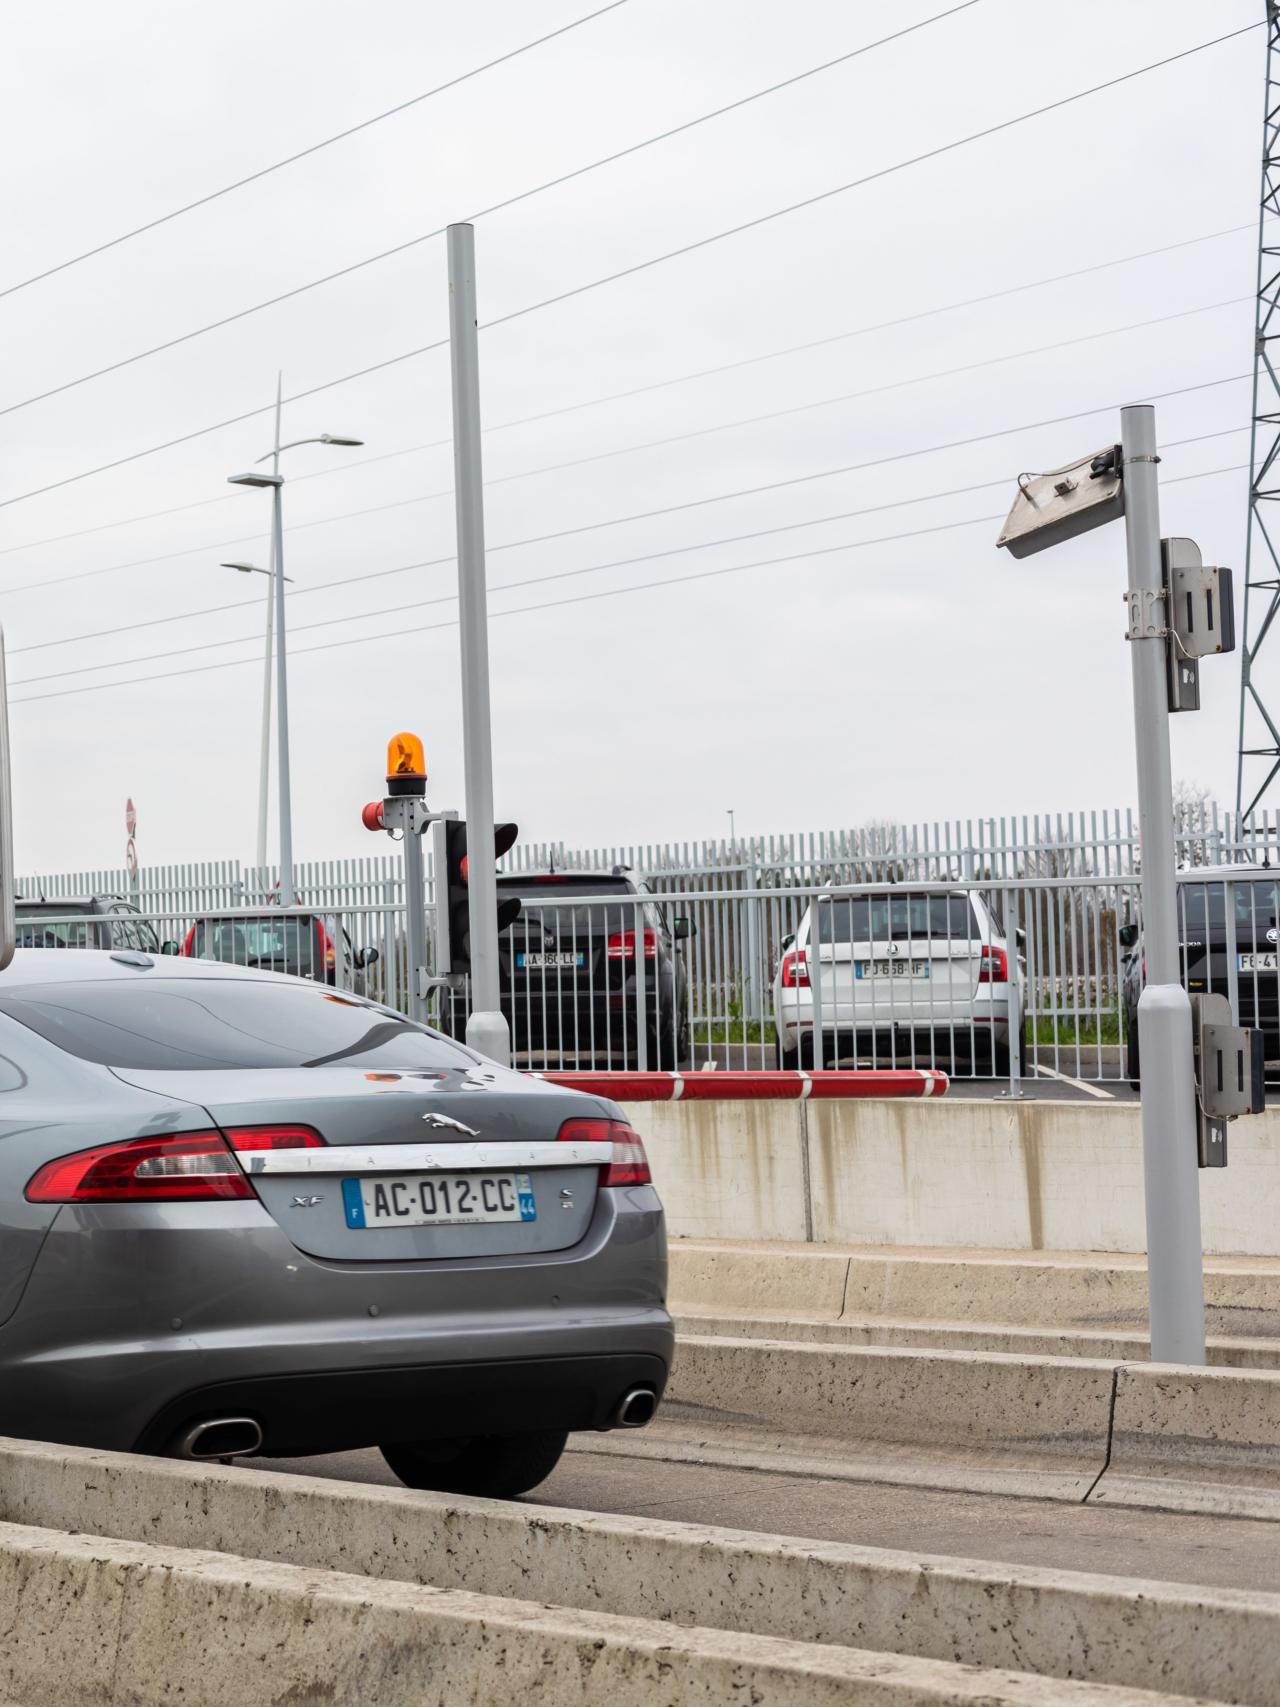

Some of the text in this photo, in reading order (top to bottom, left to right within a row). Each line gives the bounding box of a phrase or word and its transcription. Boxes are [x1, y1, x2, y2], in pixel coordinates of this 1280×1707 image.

[307, 1150, 578, 1168] JAGUAR
[289, 1195, 324, 1208] XF
[521, 1199, 535, 1214] 44
[351, 1208, 359, 1219] F
